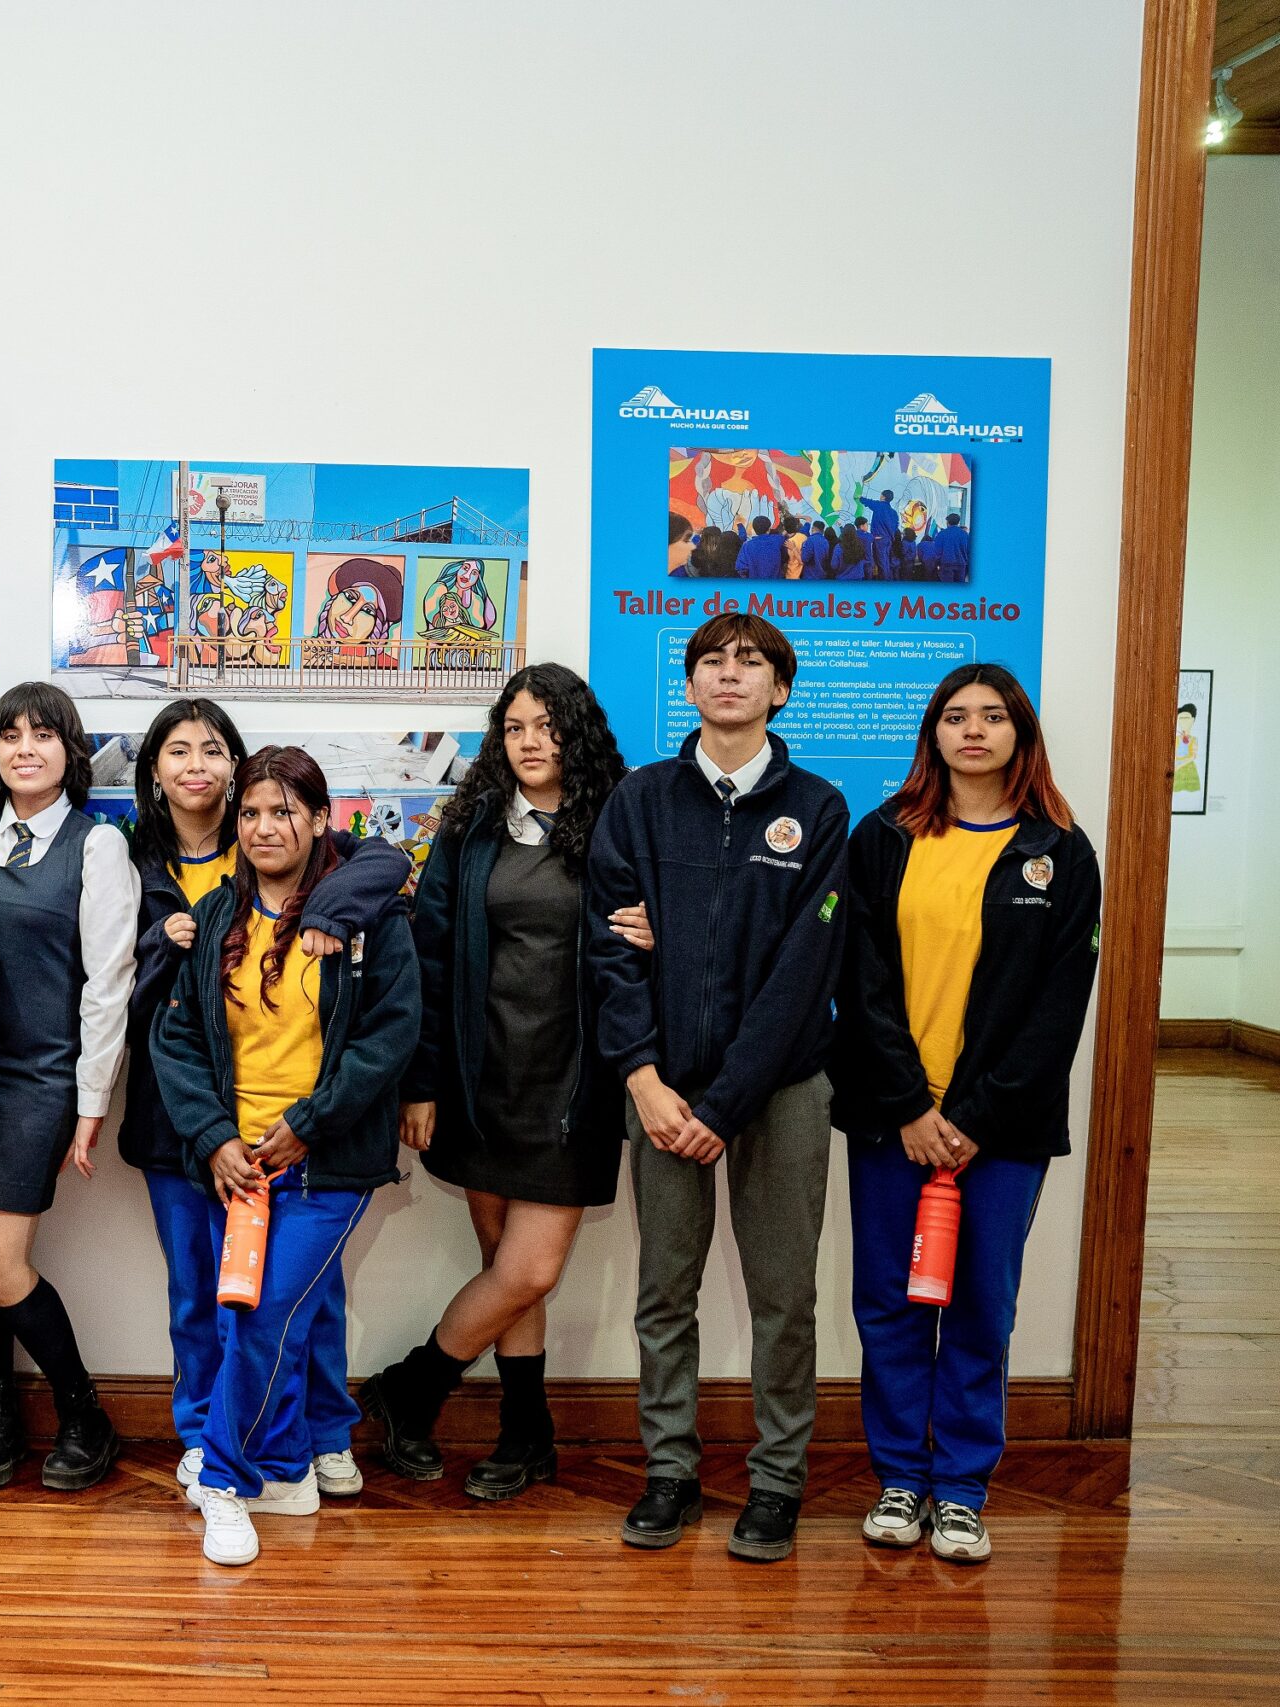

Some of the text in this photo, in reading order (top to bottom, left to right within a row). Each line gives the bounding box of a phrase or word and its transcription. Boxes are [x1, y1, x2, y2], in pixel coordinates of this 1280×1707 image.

[619, 407, 750, 421] COLLAHUASI
[895, 413, 958, 424] FUNDACIÓN
[696, 421, 710, 430] MÁS
[726, 423, 749, 431] COBRE
[894, 423, 1024, 437] COLLAHUASI
[613, 589, 1021, 627] Taller de Murales y Mosaico
[825, 639, 851, 647] realizó
[852, 639, 860, 647] el
[884, 639, 915, 648] Murales
[916, 642, 922, 650] y
[923, 640, 958, 649] Mosaico,
[668, 648, 686, 657] carg
[814, 649, 845, 657] Lorenzo
[869, 649, 899, 658] Antonio
[900, 650, 926, 659] Molina
[927, 653, 933, 661] y
[935, 650, 964, 659] Cristian
[797, 659, 828, 668] ndación
[668, 678, 678, 686] La
[798, 680, 826, 688] talleres
[827, 681, 876, 690] contemplaba
[667, 689, 675, 697] el
[791, 690, 811, 698] Chile
[812, 692, 818, 700] y
[832, 691, 861, 699] nuestro
[905, 692, 927, 701] luego
[785, 700, 806, 709] seño
[806, 701, 817, 709] de
[851, 702, 873, 710] como
[907, 702, 915, 710] la
[783, 711, 794, 719] de
[797, 711, 809, 719] los
[811, 711, 856, 720] estudiantes
[858, 712, 869, 720] en
[871, 712, 879, 720] la
[881, 712, 918, 721] ejecución
[814, 721, 822, 729] el
[872, 722, 880, 730] el
[880, 722, 916, 732] propósito
[813, 732, 824, 740] de
[825, 732, 836, 740] un
[861, 733, 877, 742] que
[877, 732, 904, 742] integre
[882, 779, 900, 787] Alan
[912, 1233, 924, 1263] UMA
